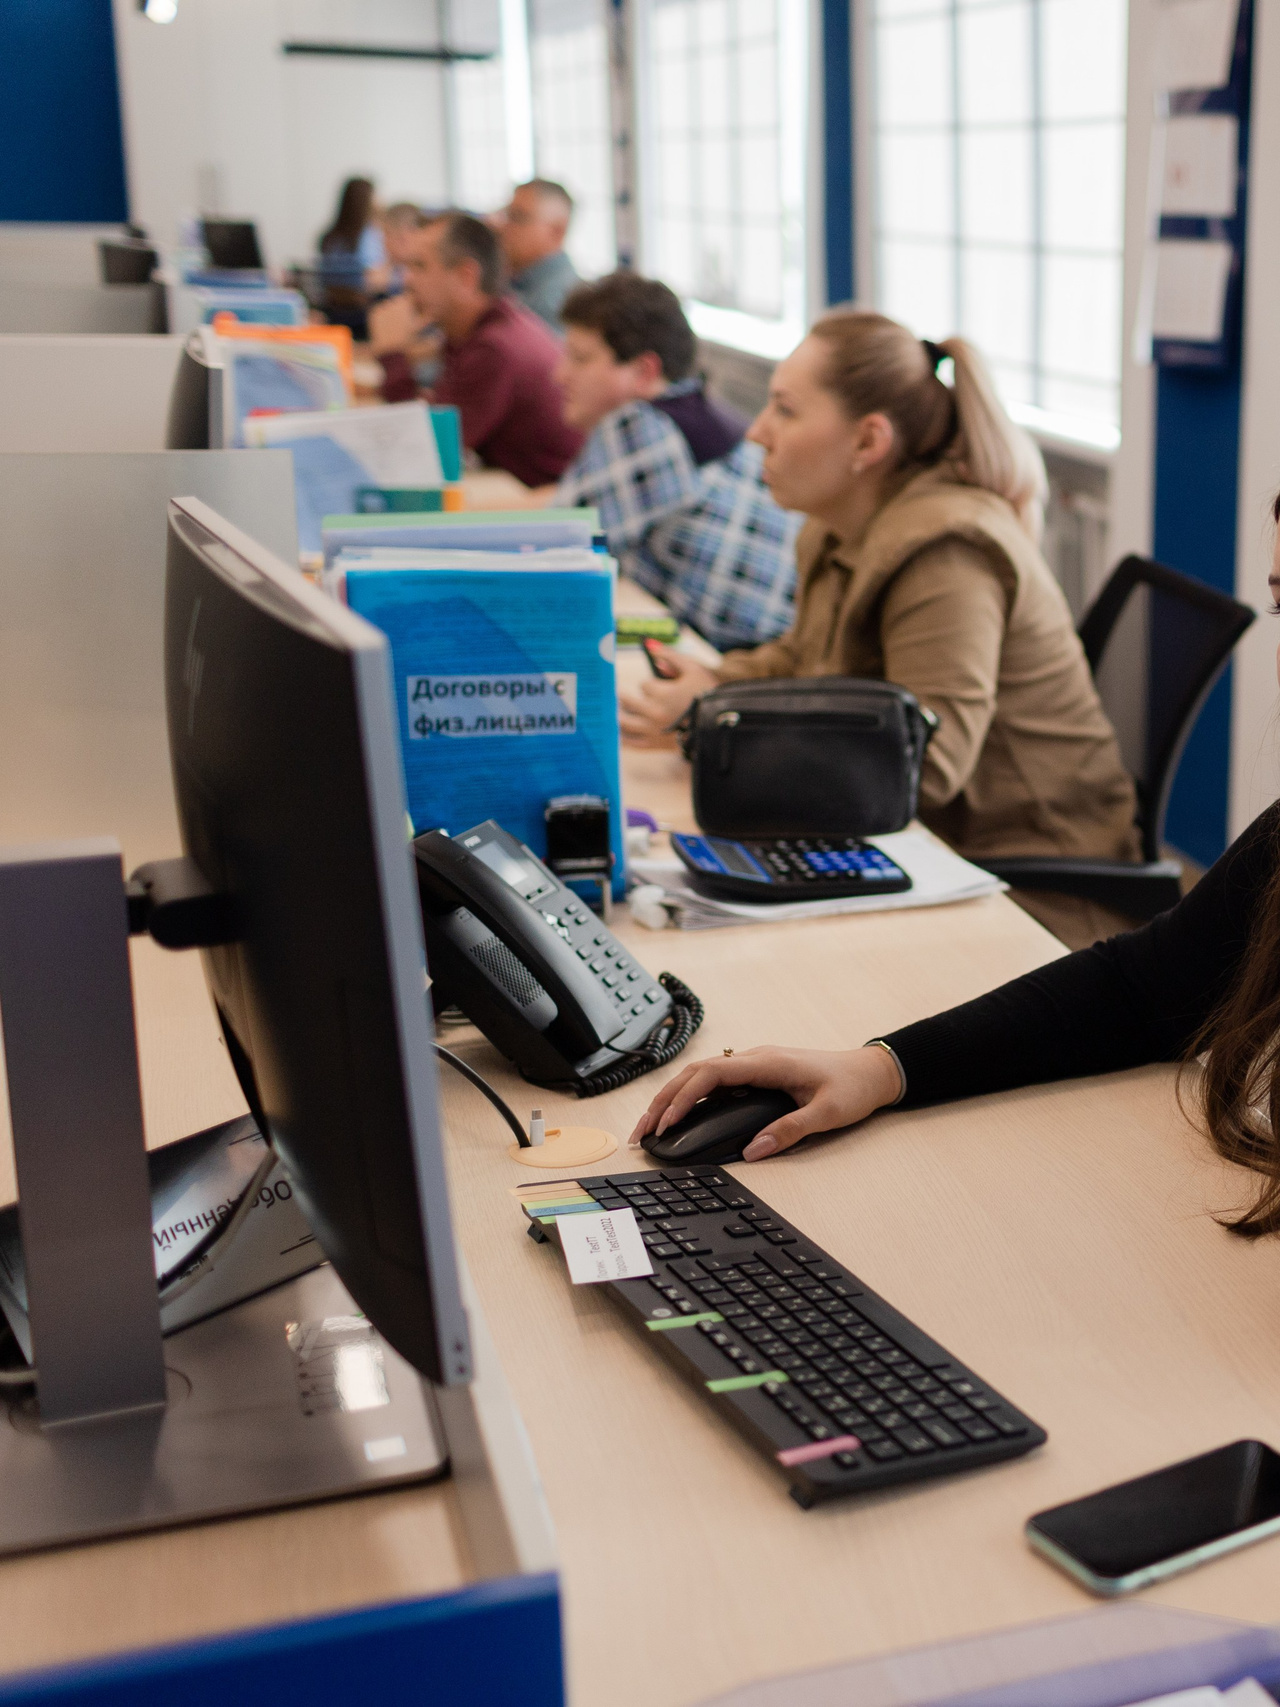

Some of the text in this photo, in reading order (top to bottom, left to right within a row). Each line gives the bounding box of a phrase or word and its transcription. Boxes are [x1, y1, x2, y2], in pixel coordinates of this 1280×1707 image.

[412, 678, 566, 702] Договоры с
[414, 713, 574, 738] физ.лицами
[153, 1180, 293, 1252] Обенный
